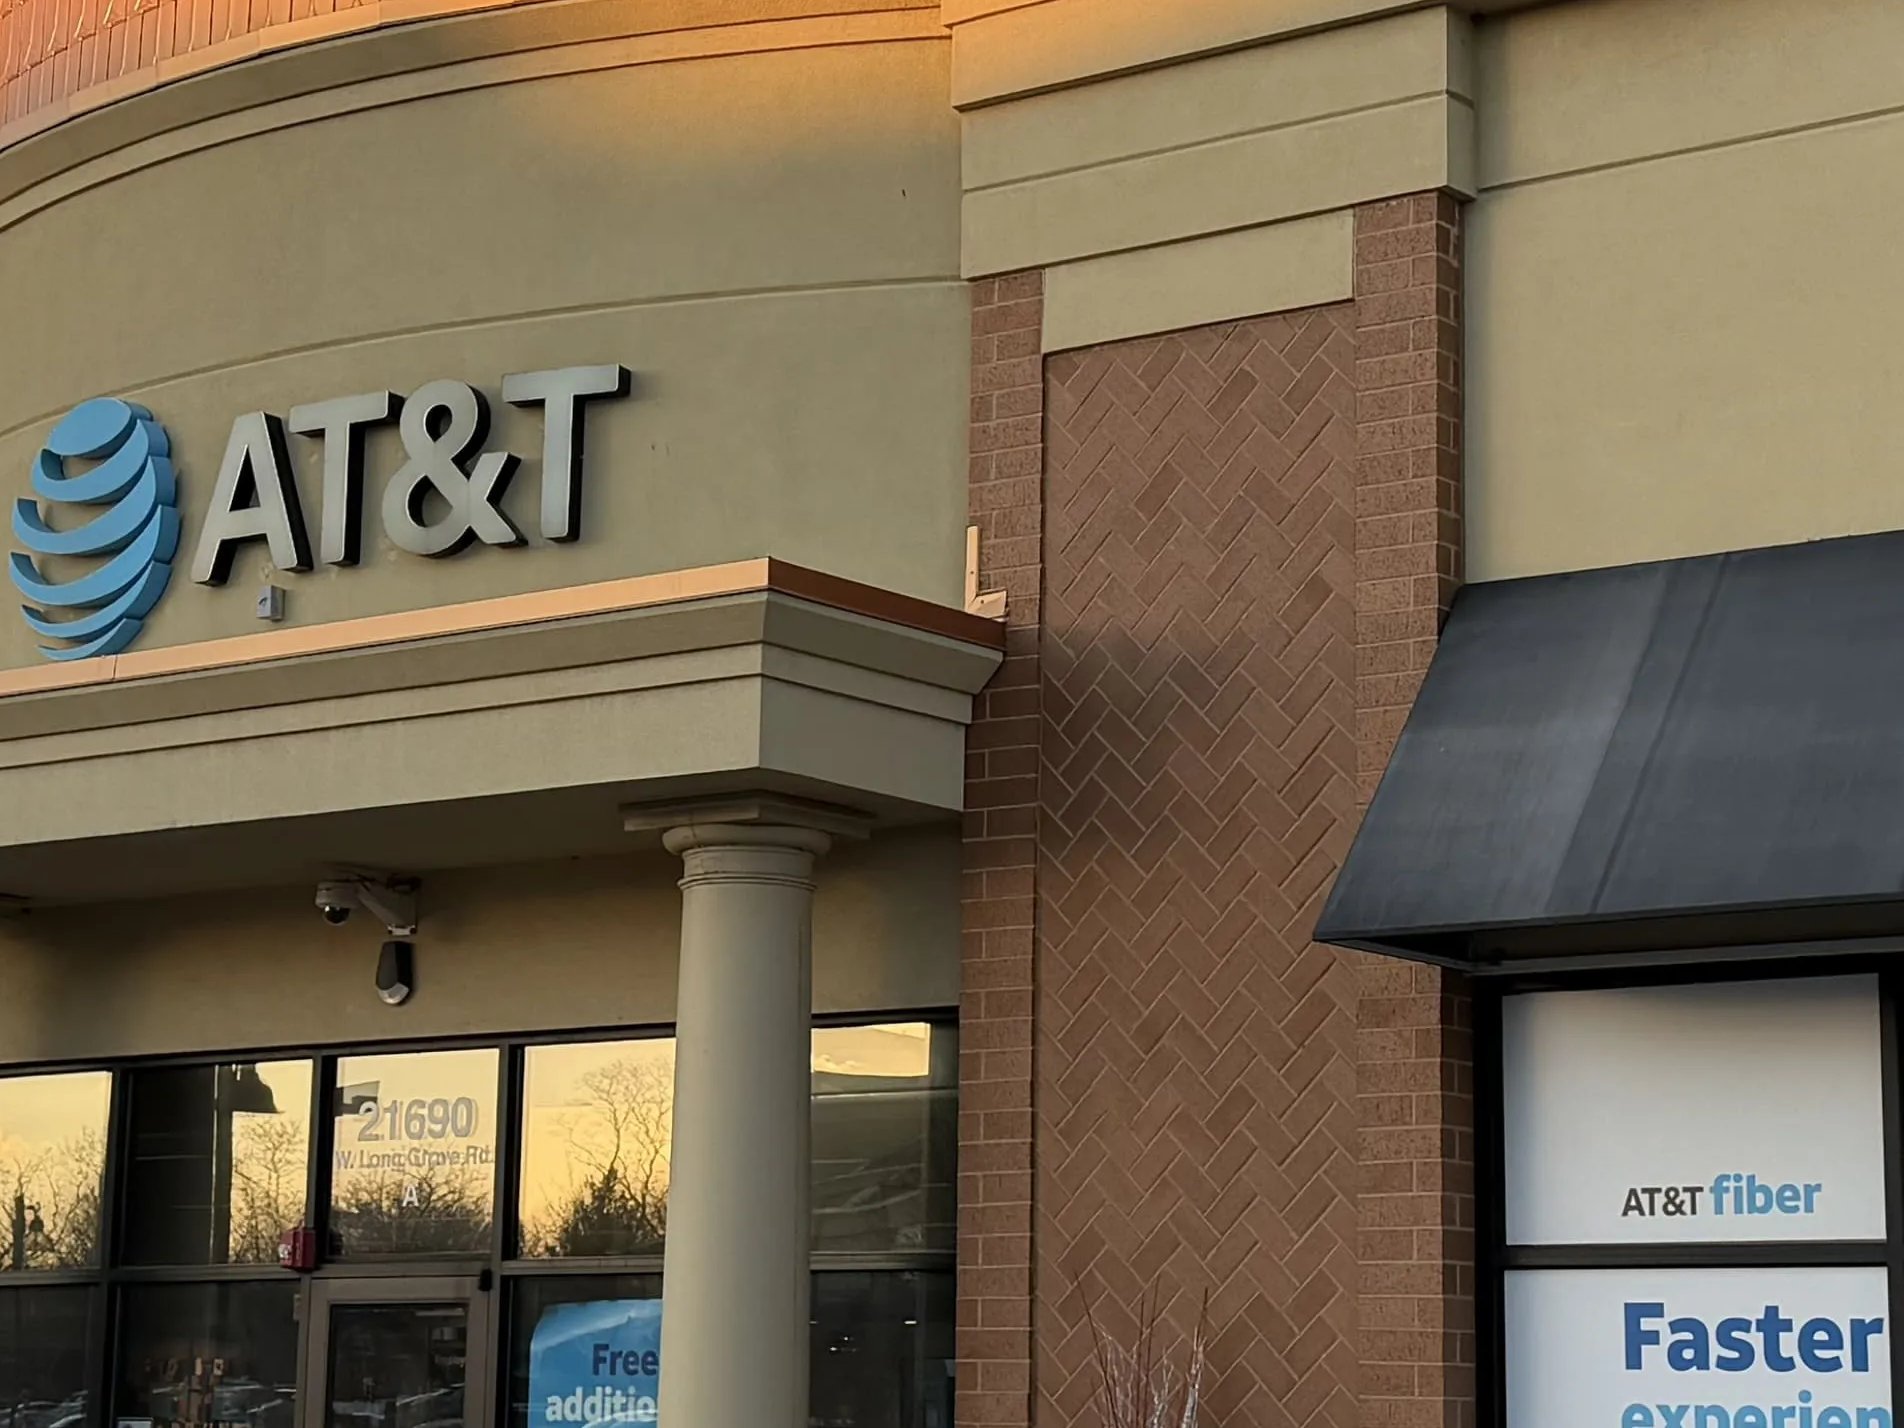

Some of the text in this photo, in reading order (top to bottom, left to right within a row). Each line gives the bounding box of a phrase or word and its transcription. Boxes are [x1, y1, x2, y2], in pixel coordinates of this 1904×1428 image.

[191, 364, 630, 586] AT&T
[357, 1097, 475, 1142] 21690
[359, 1149, 405, 1172] Long
[406, 1146, 460, 1168] Grove
[402, 1183, 419, 1207] A
[1621, 1173, 1822, 1217] AT&T fiber
[1623, 1302, 1884, 1373] Faster
[592, 1343, 660, 1376] Free
[546, 1385, 659, 1423] additio
